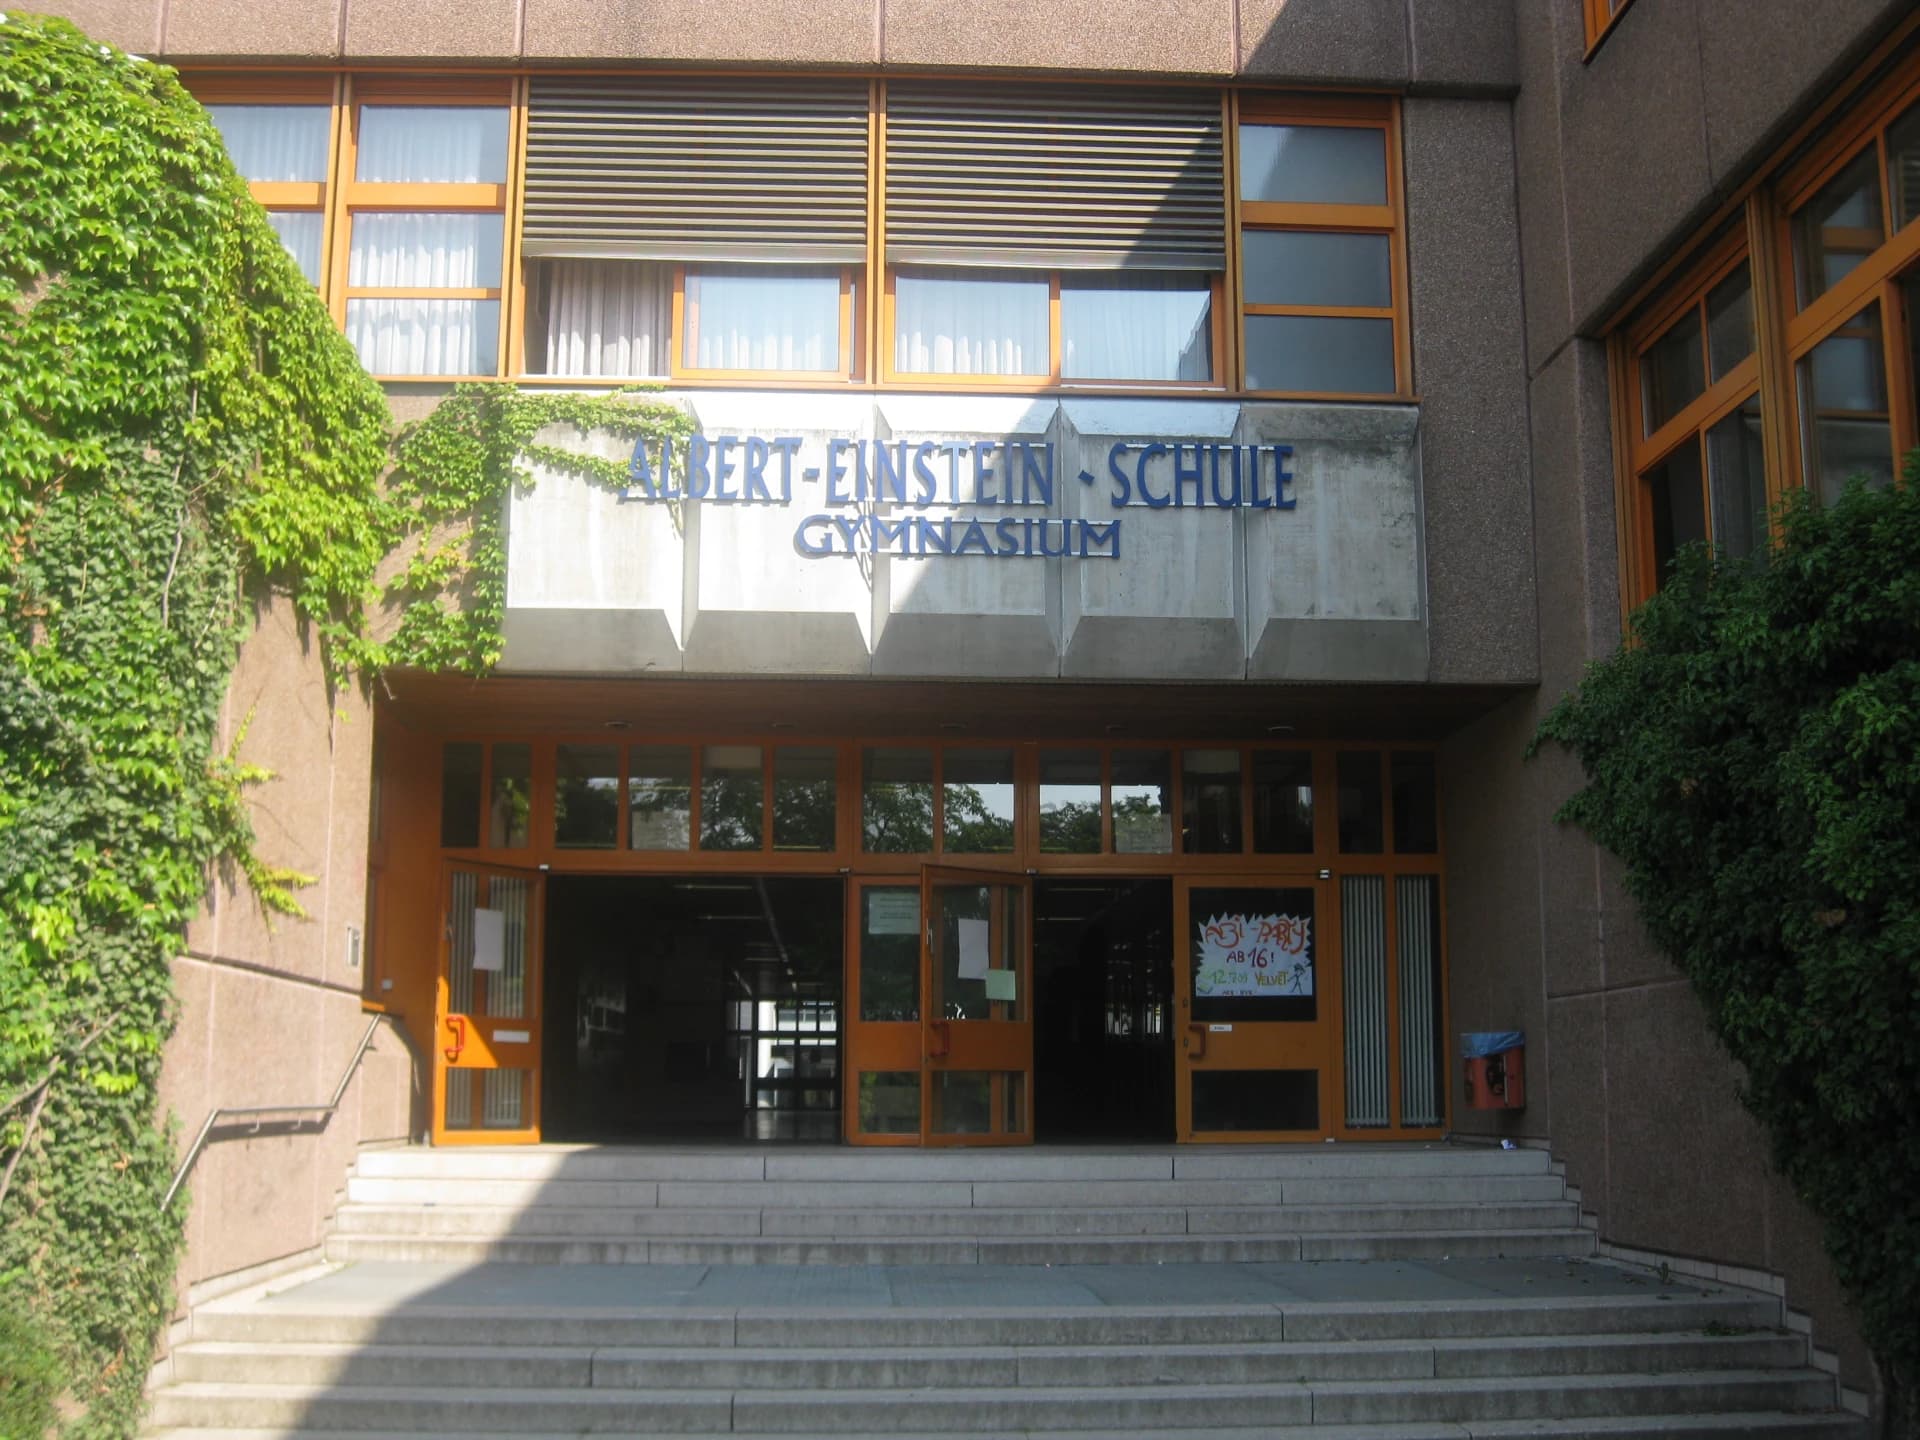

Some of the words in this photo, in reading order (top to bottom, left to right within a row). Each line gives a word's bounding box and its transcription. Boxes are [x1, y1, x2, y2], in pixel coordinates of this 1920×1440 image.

[1108, 442, 1297, 509] SCHULE
[796, 513, 1122, 559] GYMNASIUM
[1226, 950, 1245, 963] AB
[1254, 970, 1289, 987] VELVET
